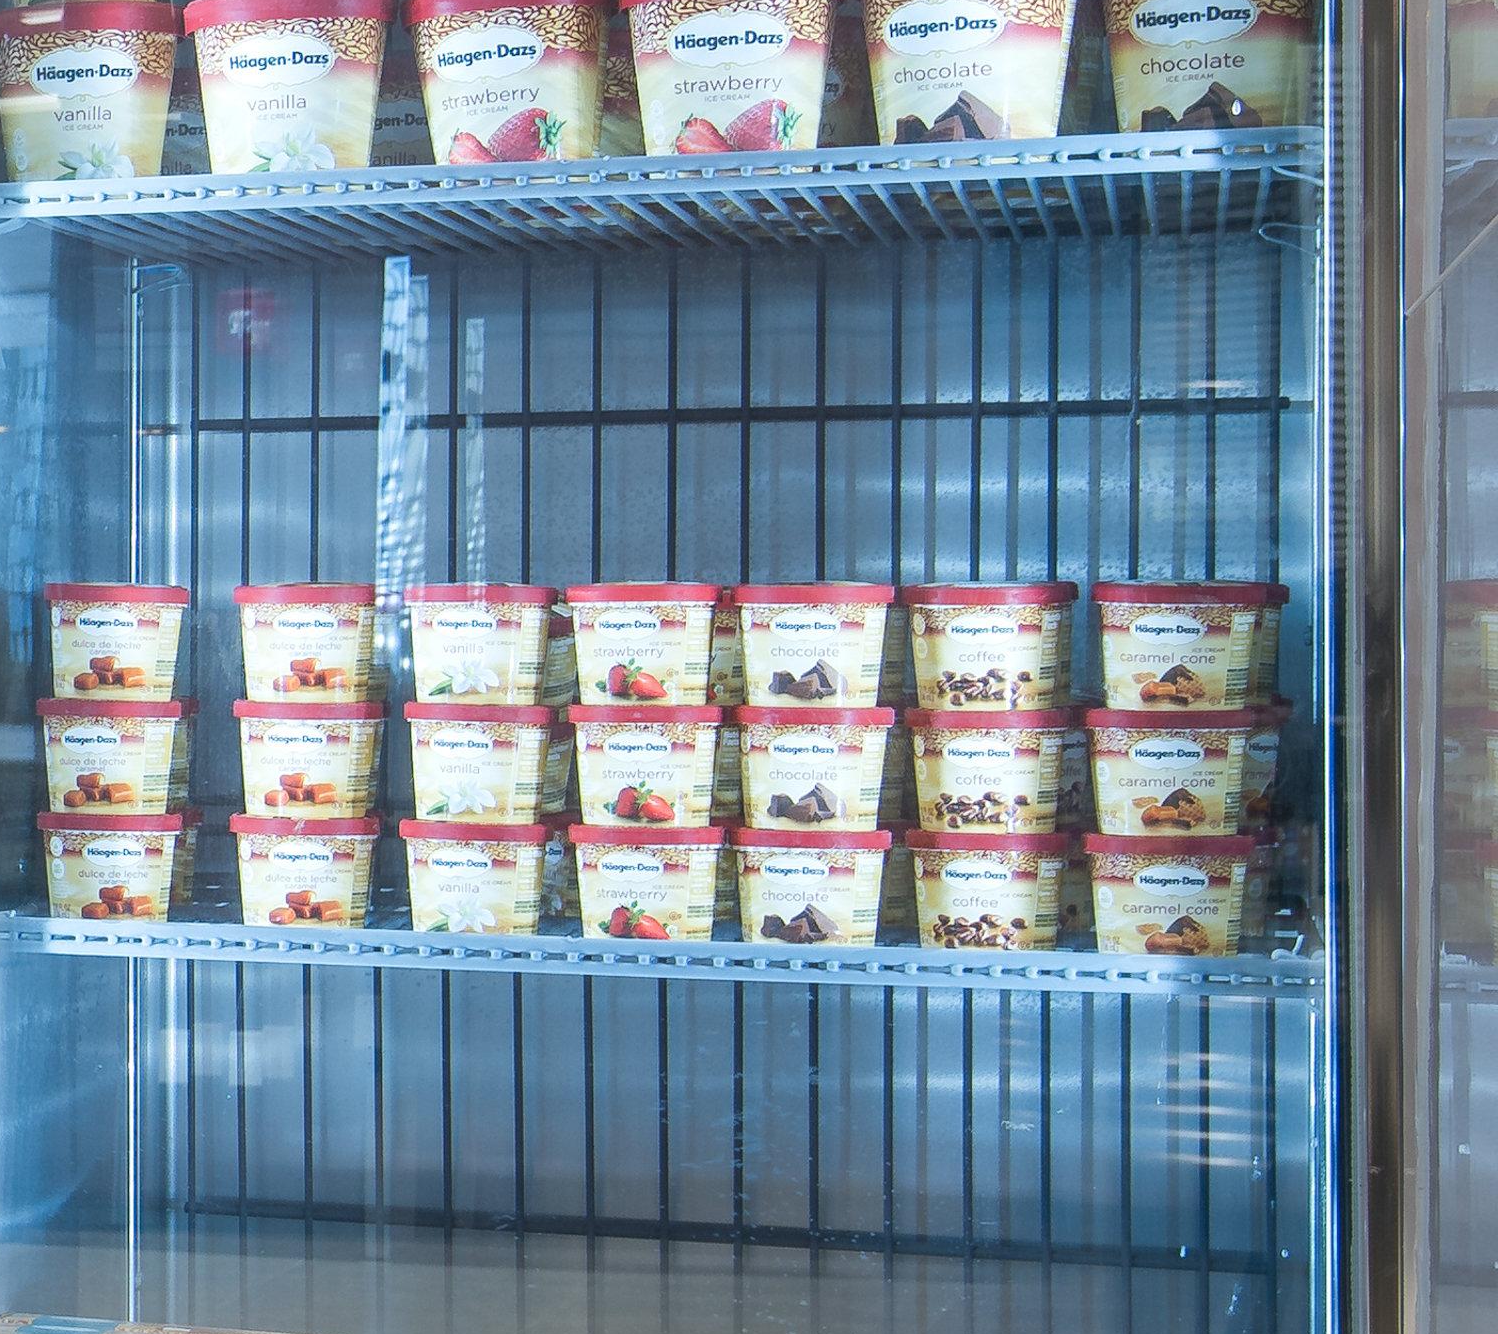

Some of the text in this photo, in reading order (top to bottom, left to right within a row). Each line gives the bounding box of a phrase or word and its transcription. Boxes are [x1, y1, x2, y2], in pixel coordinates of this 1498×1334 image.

[888, 12, 998, 39] Häagen-Dazs
[228, 49, 330, 71] Häagen-Dazs
[442, 643, 484, 654] vanilla
[592, 646, 665, 660] strawberry
[770, 645, 840, 658] chocolate
[958, 650, 1006, 662] coffee
[1119, 652, 1217, 665] caramel cone
